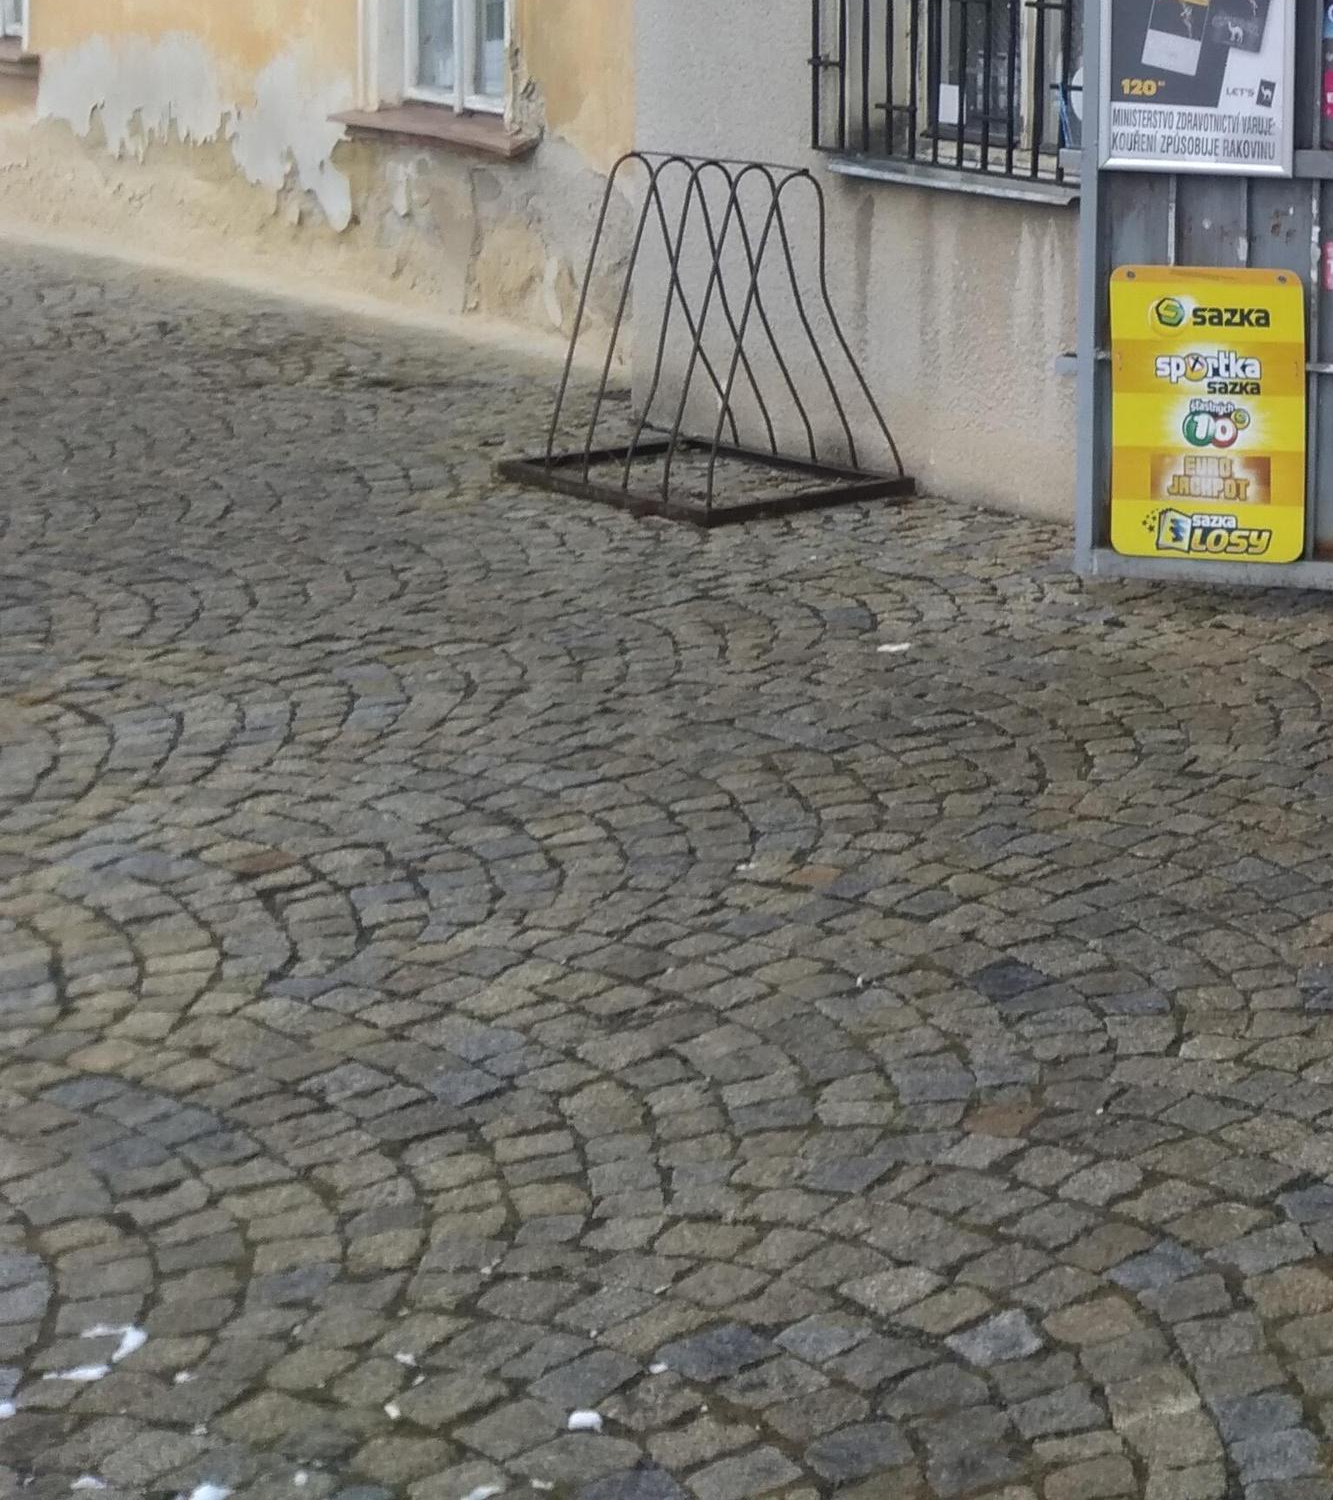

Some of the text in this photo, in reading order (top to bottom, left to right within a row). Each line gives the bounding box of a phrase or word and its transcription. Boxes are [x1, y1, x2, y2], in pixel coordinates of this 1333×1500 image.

[1121, 79, 1156, 96] 120
[1226, 87, 1254, 97] LET'S
[1112, 108, 1174, 130] MINISTERSTVO
[1176, 111, 1240, 135] ZDRAVOTNICTVÍ
[1112, 130, 1275, 160] KOUŘENÍ ZPŮSOBUJE RAKOVINU
[1192, 307, 1270, 328] sazka
[1155, 350, 1262, 384] sportka
[1207, 381, 1261, 395] sazka
[1191, 411, 1237, 443] 10
[1184, 456, 1233, 478] EURO
[1167, 475, 1250, 501] JACKPOT
[1192, 514, 1237, 529] sazka
[1191, 527, 1271, 554] LOSY
